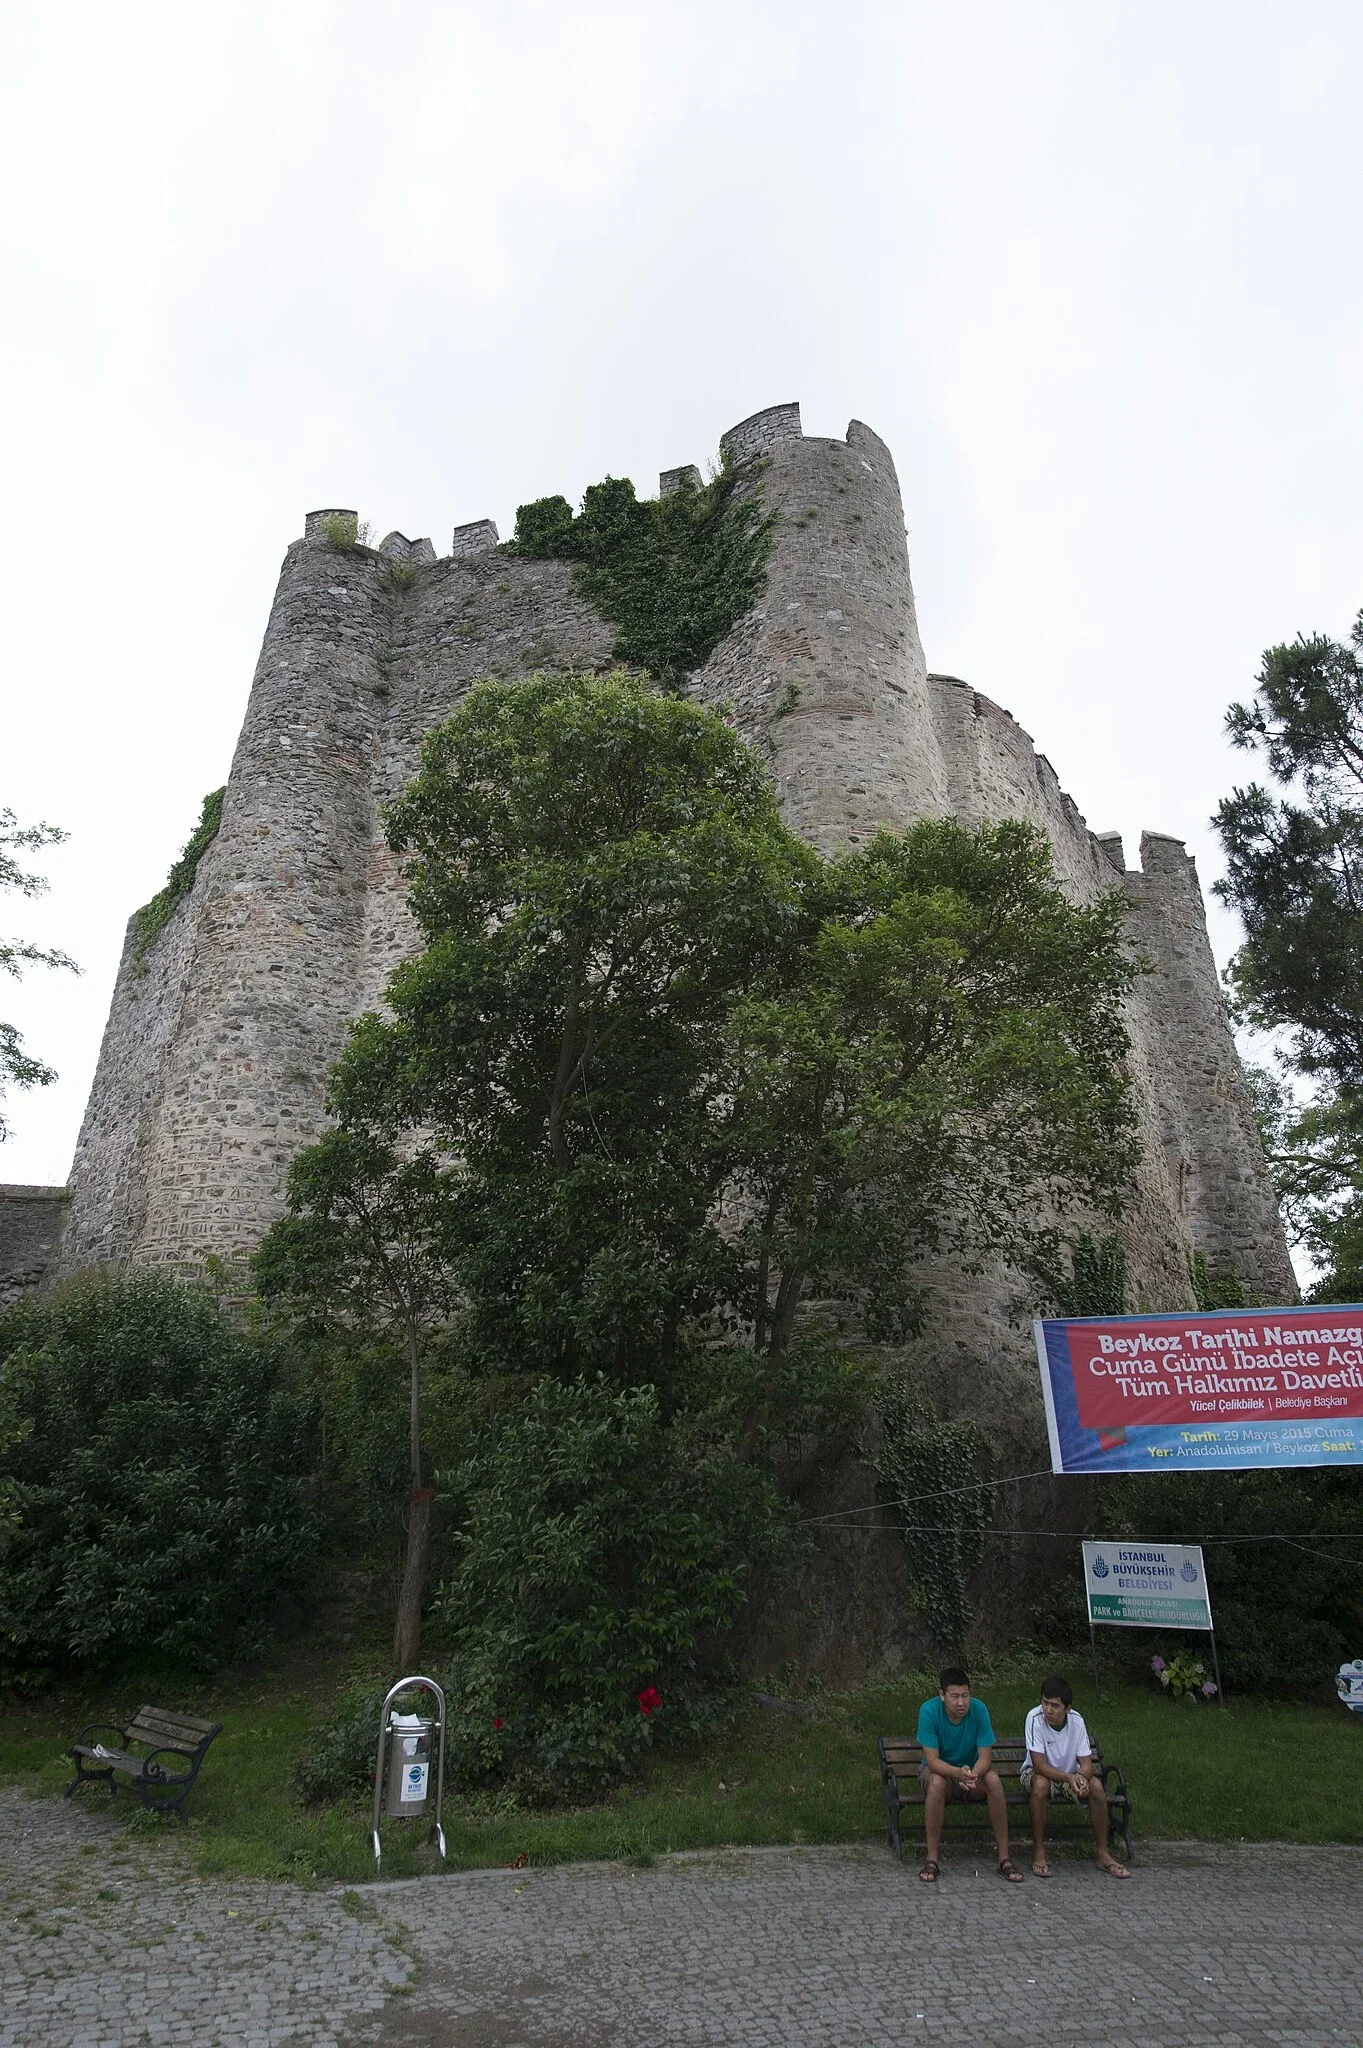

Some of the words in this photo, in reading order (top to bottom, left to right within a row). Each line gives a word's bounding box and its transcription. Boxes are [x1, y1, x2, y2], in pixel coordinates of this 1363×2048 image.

[1099, 1334, 1183, 1357] Beykoz
[1185, 1328, 1259, 1350] Tarihi
[1263, 1327, 1363, 1347] Namazg
[1089, 1357, 1158, 1376] Cuma
[1162, 1352, 1228, 1373] Günü
[1232, 1348, 1321, 1370] İbadete
[1327, 1346, 1363, 1370] Açı
[1115, 1377, 1171, 1397] Tüm
[1176, 1374, 1278, 1395] Halkımız
[1282, 1368, 1363, 1391] Davetli
[1190, 1401, 1216, 1411] Yücel
[1218, 1397, 1265, 1414] Çelikbilek
[1275, 1395, 1312, 1409] Belediye
[1313, 1395, 1348, 1408] Başkanı
[1180, 1432, 1221, 1443] Tarih:
[1224, 1430, 1239, 1441] 29
[1242, 1428, 1279, 1443] Mayıs
[1281, 1428, 1312, 1440] 2015
[1314, 1426, 1355, 1438] Cuma
[1147, 1446, 1174, 1458] Yer:
[1176, 1443, 1263, 1458] Anadoluhisarı
[1273, 1441, 1320, 1456] Beykoz
[1321, 1440, 1357, 1453] Saat:
[1119, 1549, 1167, 1562] İSTANBUL
[1113, 1563, 1176, 1579] BÜYÜKŞEHİR
[1118, 1578, 1173, 1591] BELEDİYESİ
[1117, 1598, 1152, 1606] ANADOLU
[1093, 1606, 1112, 1617] PARK
[1122, 1608, 1157, 1620] BAHÇELER
